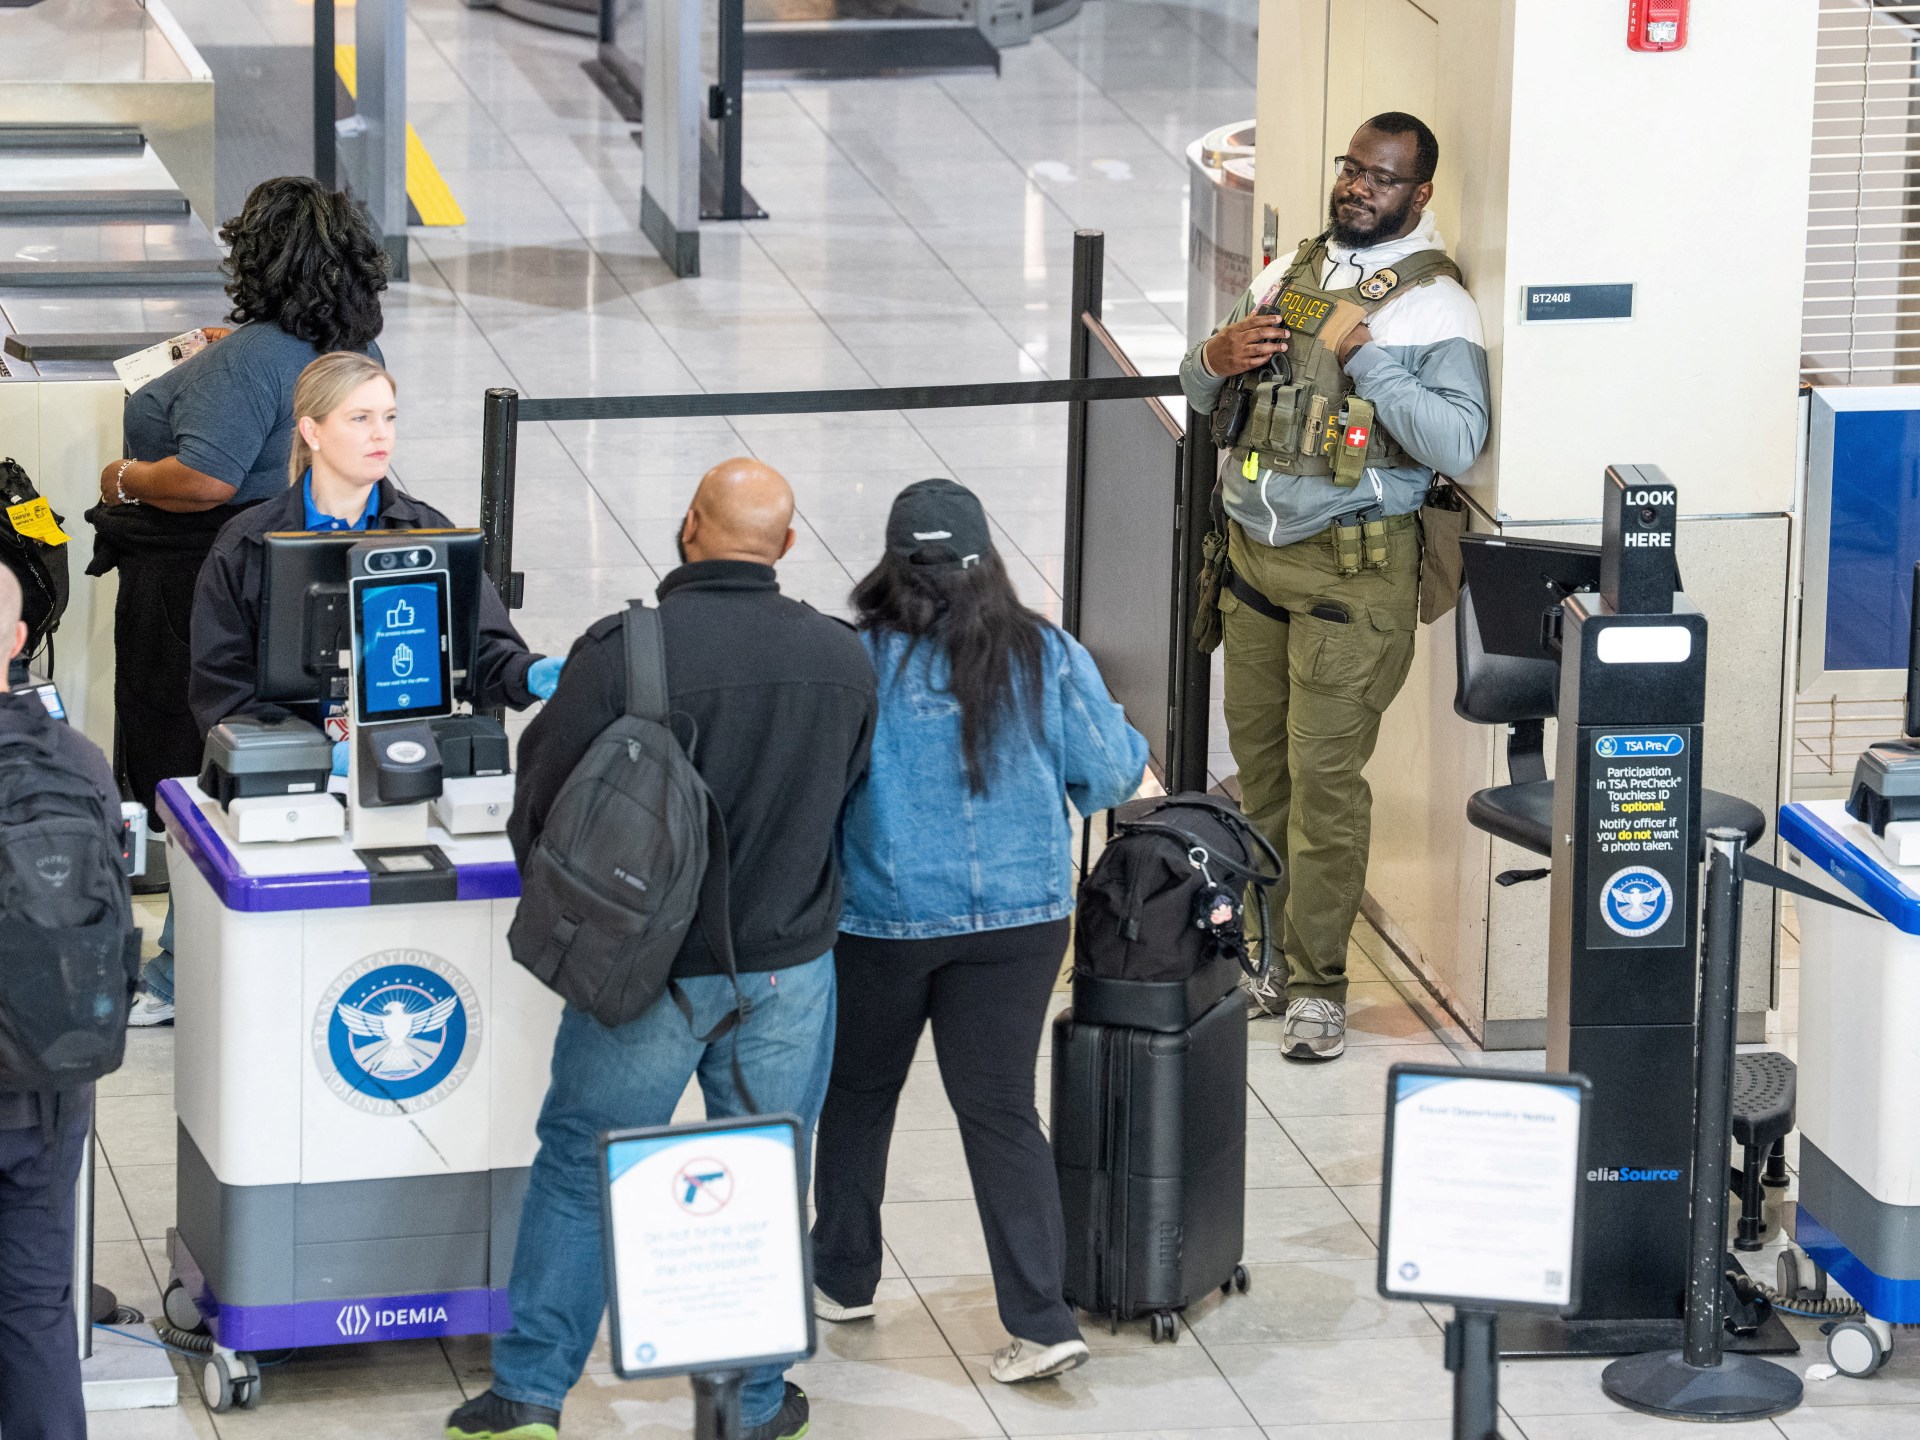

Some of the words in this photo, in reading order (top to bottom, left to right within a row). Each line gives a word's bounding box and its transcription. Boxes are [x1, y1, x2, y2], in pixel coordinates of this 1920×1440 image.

[1532, 293, 1571, 303] BT240B
[1280, 292, 1329, 318] POLICE
[1284, 312, 1309, 329] ICE
[1626, 491, 1675, 506] LOOK
[1625, 532, 1672, 547] HERE
[1625, 741, 1644, 751] TSA
[1607, 766, 1672, 778] Participation
[1596, 779, 1606, 789] in
[1608, 779, 1628, 789] TSA
[1607, 790, 1656, 801] Touchless
[1658, 790, 1670, 800] ID
[1611, 802, 1620, 812] is
[1621, 801, 1666, 813] optional.
[1600, 818, 1631, 830] Notify
[1633, 817, 1666, 828] officer
[1669, 817, 1677, 828] if
[1597, 832, 1616, 842] you
[1618, 830, 1632, 840] do
[1633, 830, 1652, 840] not
[1653, 829, 1679, 840] want
[1602, 843, 1609, 852] a
[1610, 842, 1640, 854] photo
[1642, 841, 1673, 852] taken.
[314, 951, 434, 1048] TRANSPORTATION
[437, 957, 481, 1038] SECURITY
[1586, 1167, 1680, 1181] eliaSource
[375, 1306, 448, 1327] IDEMIA
